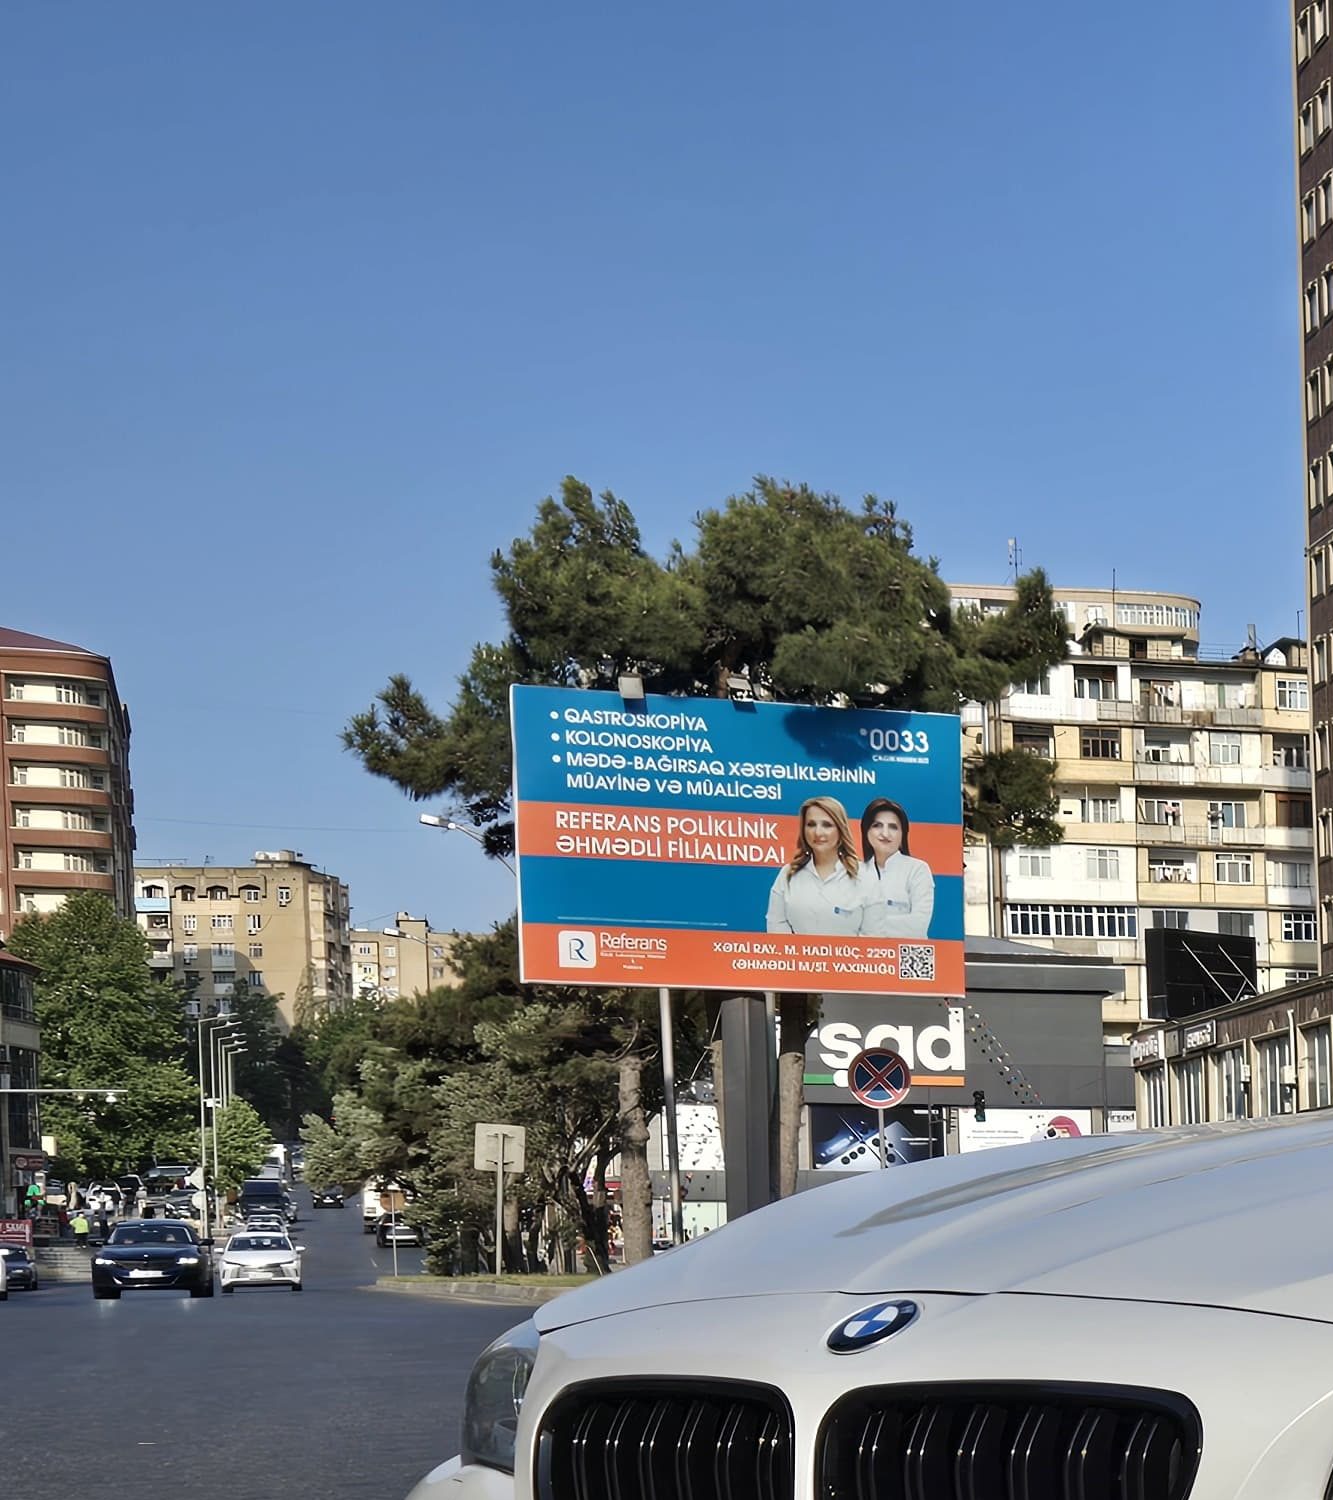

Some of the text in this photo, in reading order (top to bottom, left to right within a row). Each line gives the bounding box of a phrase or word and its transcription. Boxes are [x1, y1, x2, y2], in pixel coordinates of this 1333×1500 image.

[564, 708, 708, 731] QASTROSKOPİYA
[565, 729, 713, 753] KOLONOSKOPİYA
[566, 752, 876, 785] MƏDƏ-BAĞIRSAQ XƏSTƏLİKLƏRİNİN
[567, 772, 782, 800] MÜAYİNƏ VƏ MÜALİCƏSİ
[555, 810, 778, 840] REFERANS POLİKLİNİK
[555, 835, 785, 864] ƏHMƏDLİ FİLİALINDA!
[600, 932, 667, 951] Referans
[802, 944, 833, 957] HADİ
[809, 1007, 966, 1088] şad
